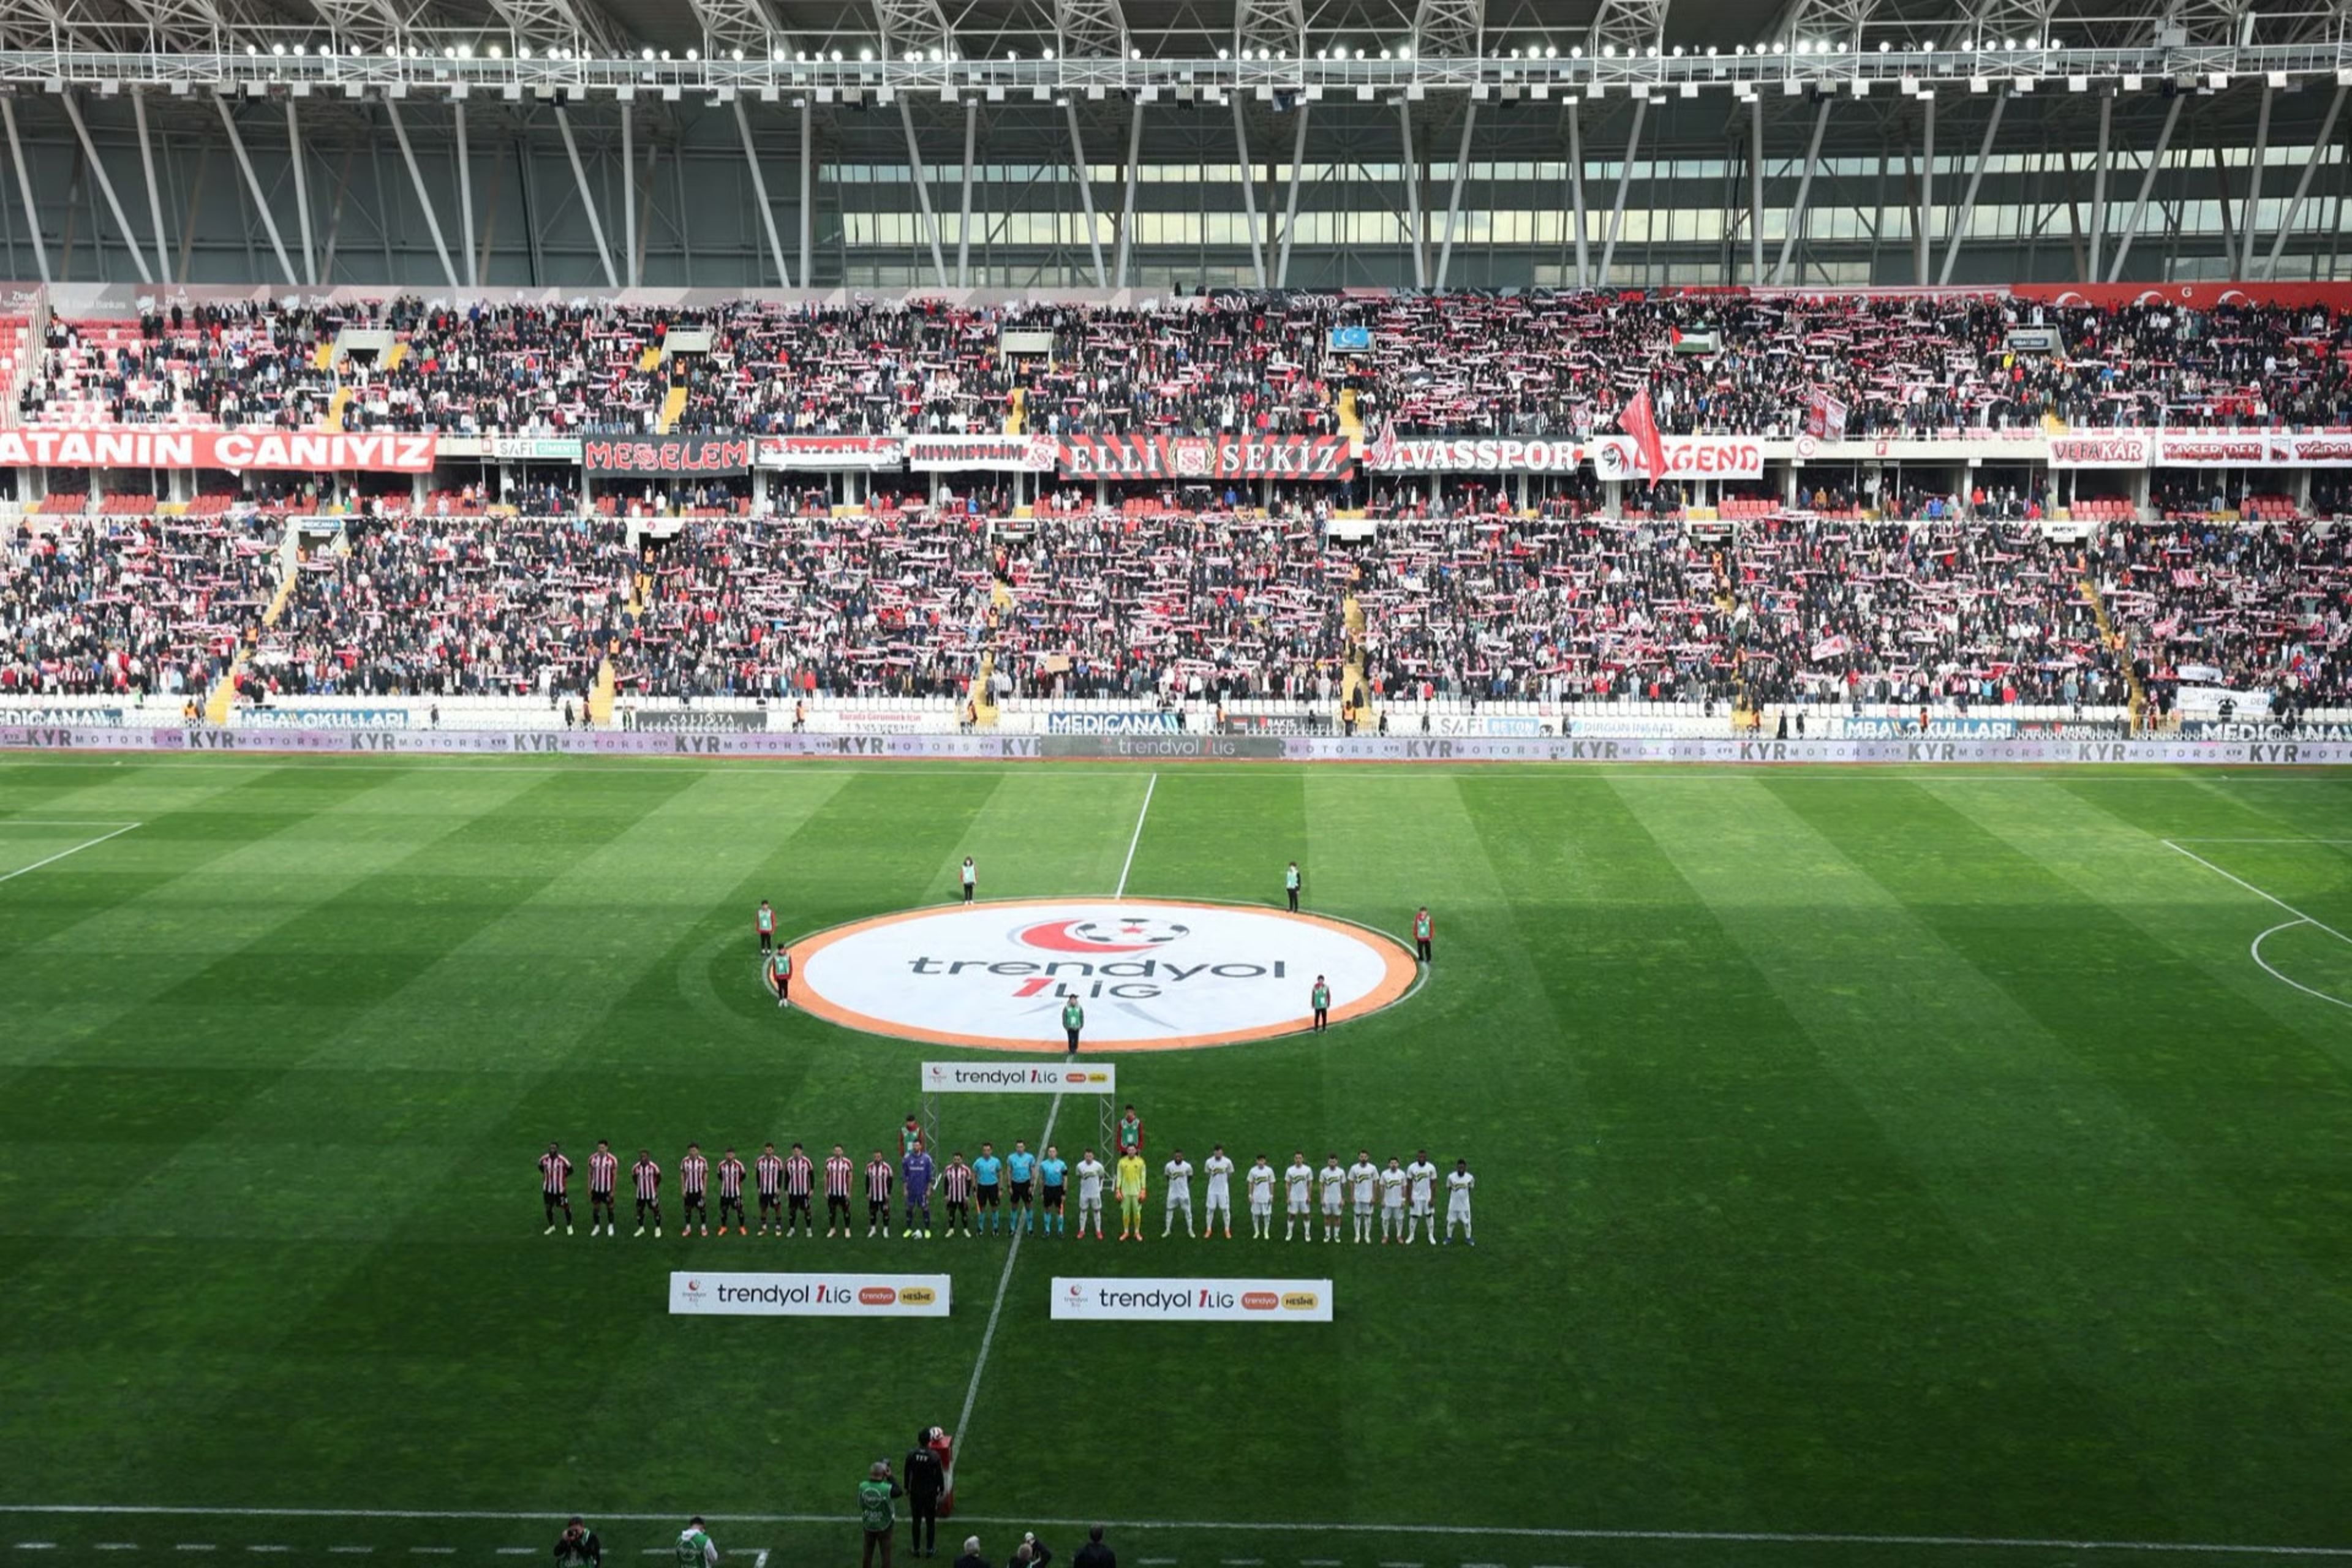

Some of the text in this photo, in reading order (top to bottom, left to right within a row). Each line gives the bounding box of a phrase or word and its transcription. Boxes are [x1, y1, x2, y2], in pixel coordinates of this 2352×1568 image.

[214, 435, 430, 466] CANIYIZ
[1070, 439, 1158, 473] ELLİ
[1222, 440, 1338, 473] SEKİZ
[1634, 444, 1758, 472] LGEND
[303, 712, 404, 729] OKULLARI
[1052, 715, 1165, 733] MEDICANA
[26, 729, 157, 747] KYR MOTORS
[190, 731, 319, 748] KYR MOTORS
[2201, 723, 2342, 741] MEDICANA
[350, 734, 481, 750] KYR MOTORS
[514, 734, 643, 751] KYR MOTORS
[675, 736, 720, 753] KYR
[839, 737, 969, 754] KYR MOTORS
[1118, 739, 1199, 755] trendyol
[1406, 741, 1452, 758] KYR
[1572, 742, 1706, 758] KYR MOTORS
[1740, 742, 1787, 760] KYR
[1908, 744, 1955, 760] KYR
[2078, 744, 2216, 761] KYR MOTORS
[2249, 744, 2299, 761] KYR
[908, 957, 1285, 981] trendyol
[955, 1069, 1025, 1085] trendyol
[718, 1284, 809, 1306] trendyol
[861, 1292, 894, 1301] trendyol
[1099, 1288, 1191, 1311] trendyol
[1245, 1297, 1277, 1306] trendyol
